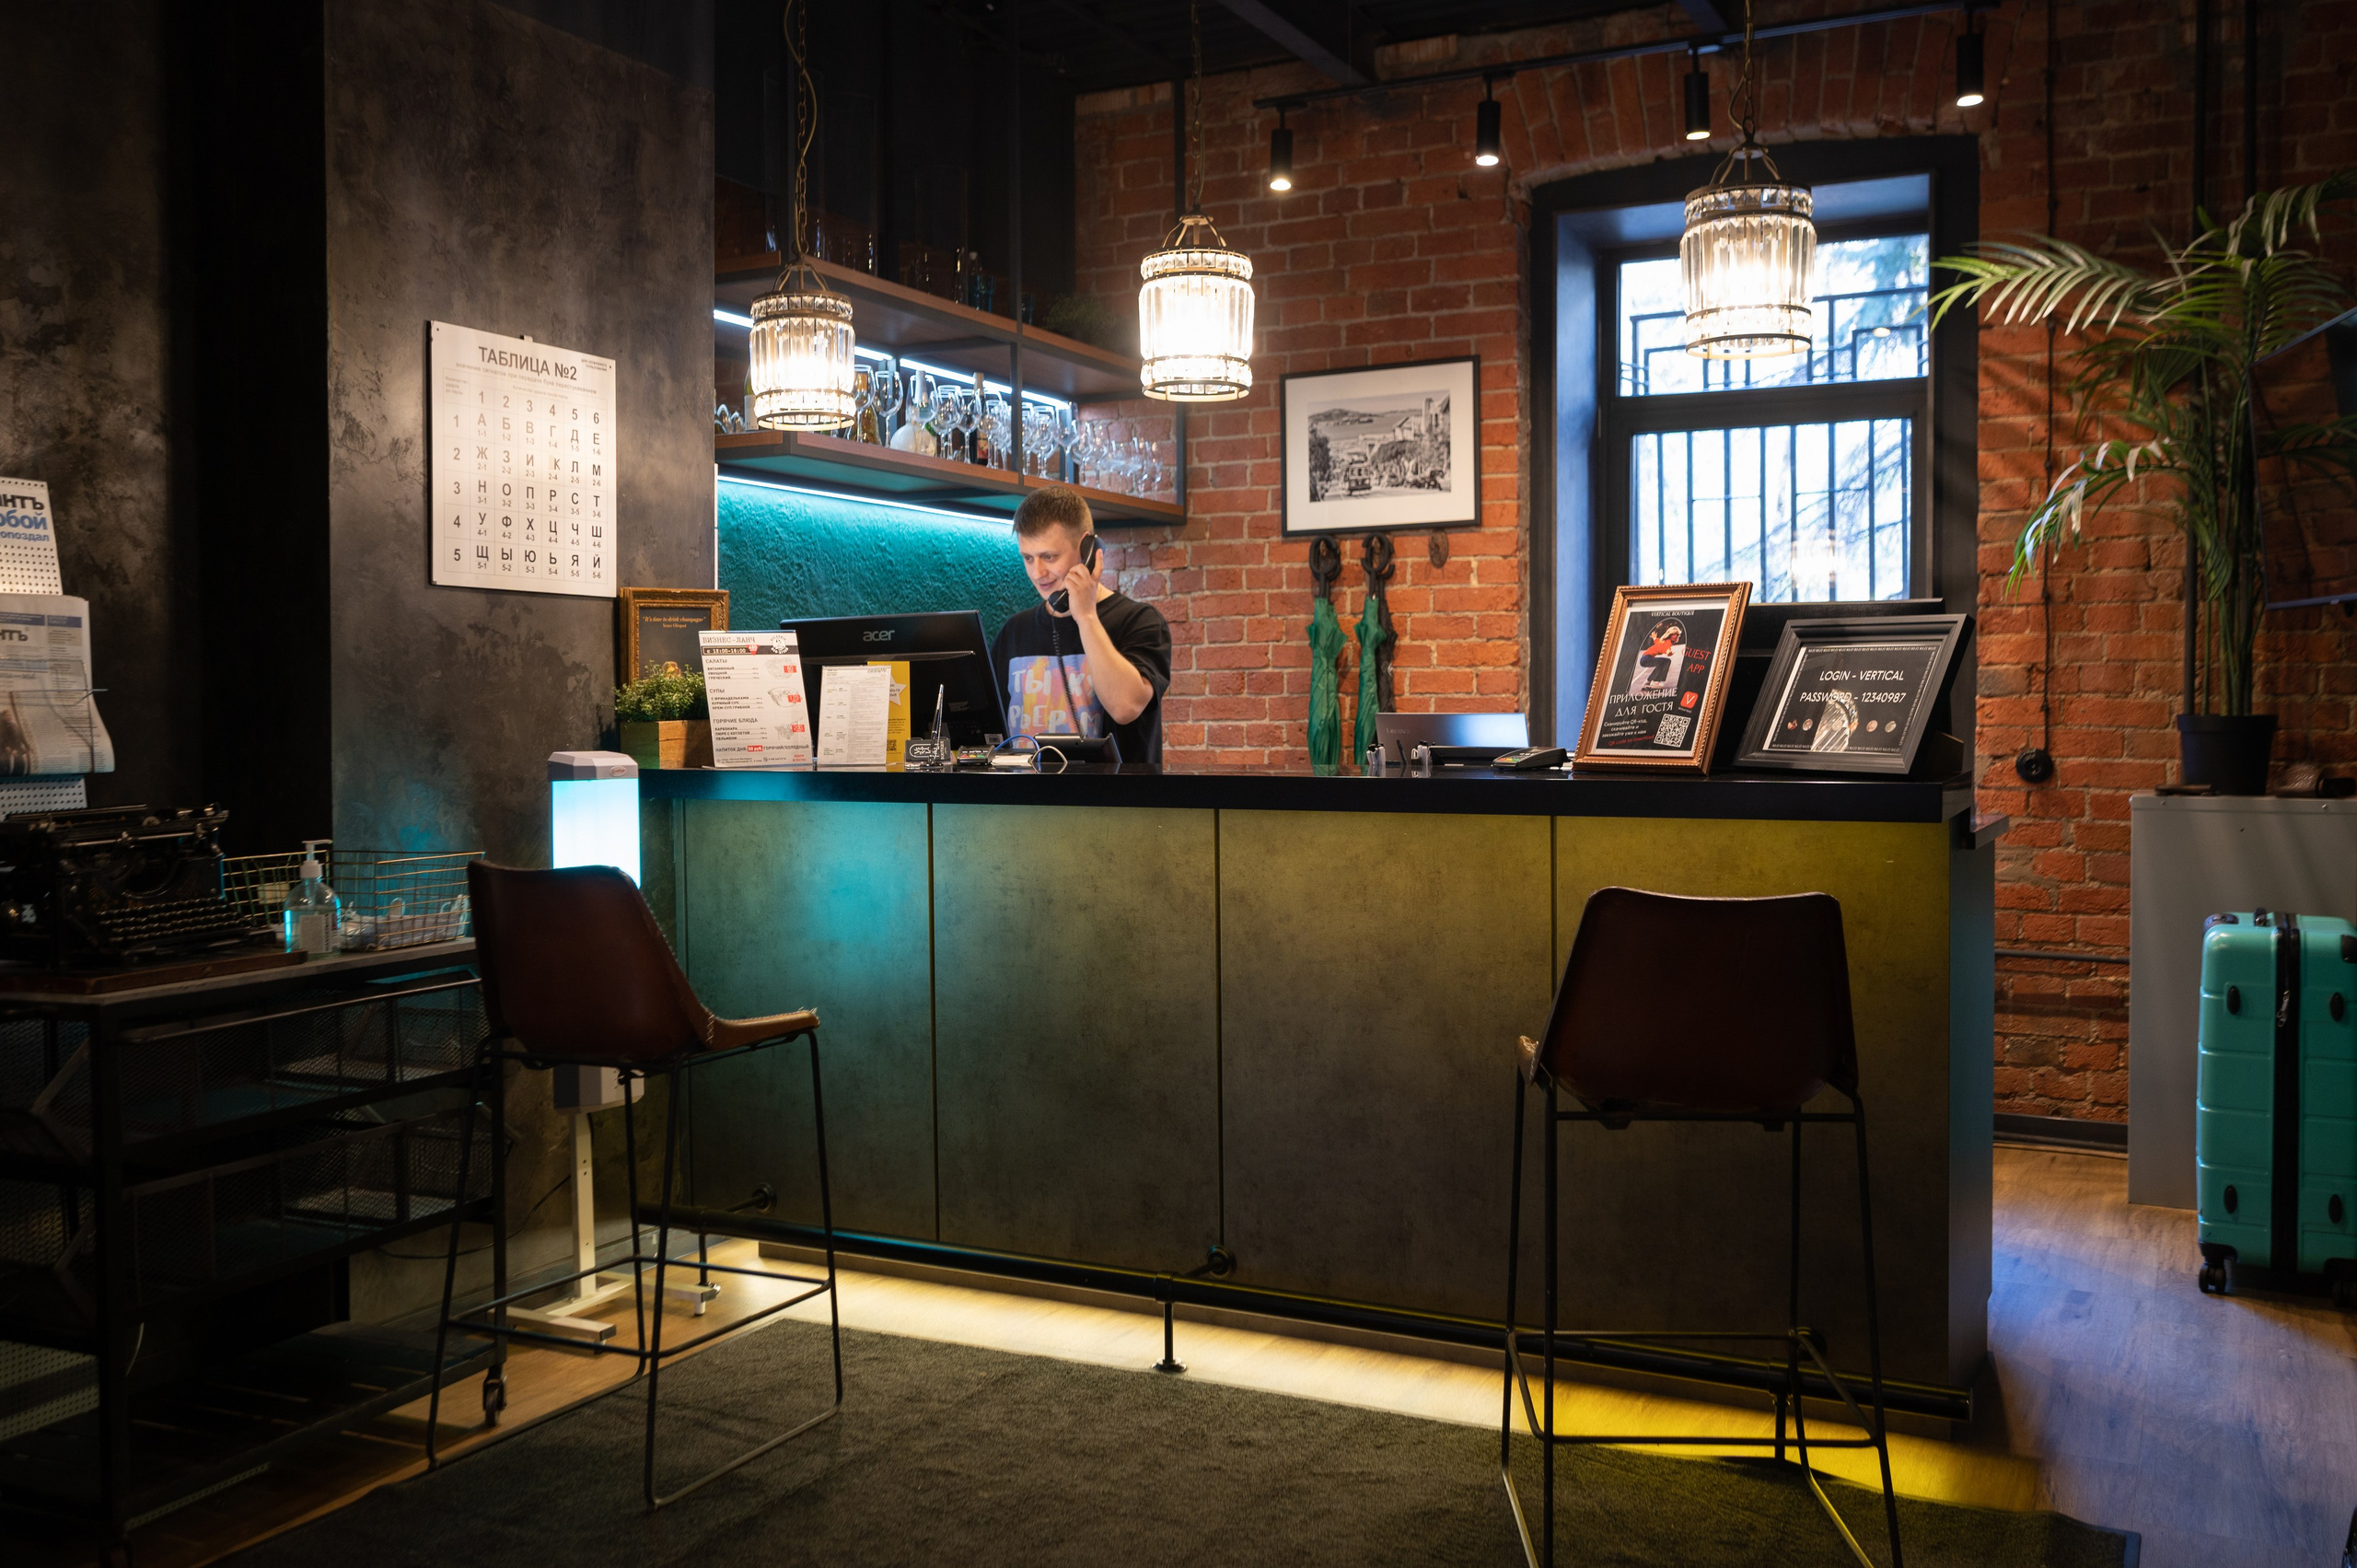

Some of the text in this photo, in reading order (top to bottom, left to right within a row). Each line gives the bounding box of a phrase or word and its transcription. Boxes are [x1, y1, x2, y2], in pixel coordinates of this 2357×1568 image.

[478, 346, 577, 381] ТАБЛИЦА №2
[507, 371, 517, 380] при
[479, 391, 599, 424] 1 2 3 4 5 6
[453, 413, 600, 445] 1 А Б В Г Д Е
[453, 446, 601, 476] 2 Ж З И К Л М
[453, 480, 600, 507] 3 Н О П Р С Т
[453, 512, 602, 538] 4 У Ф Х Ц Ч Ш
[453, 545, 600, 568] 5 Щ Ы Ю Ь Я Й
[863, 630, 895, 642] acer
[1682, 647, 1711, 661] GUEST
[1686, 663, 1705, 674] APP
[1819, 670, 1851, 681] LOGIN
[1859, 670, 1904, 681] VERTICAL
[1012, 669, 1052, 696] ТЫ
[1609, 688, 1678, 704] ПРИЛОЖЕНИЕ
[1686, 694, 1695, 705] V
[1800, 692, 1852, 702] PASSWORD
[1861, 692, 1906, 703] 12340987
[1615, 706, 1637, 717] ДЛЯ
[1642, 701, 1674, 714] ГОСТЯ
